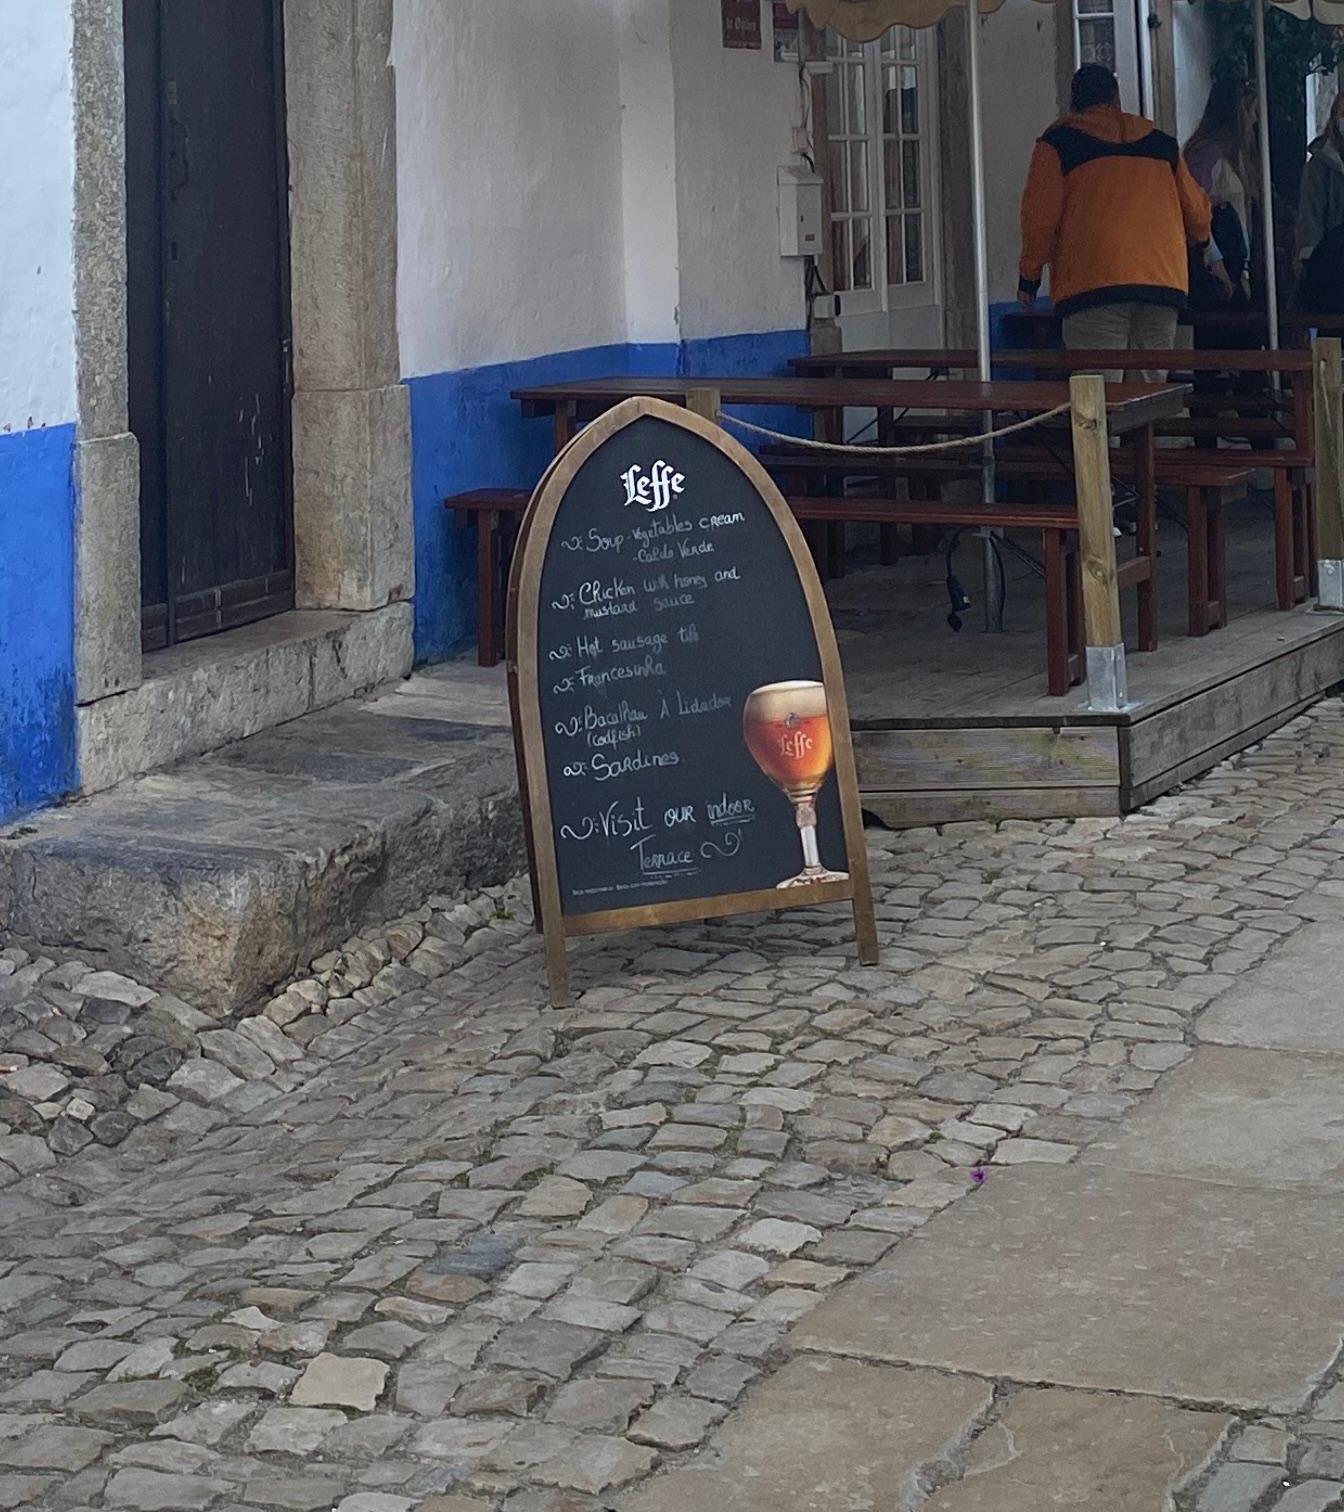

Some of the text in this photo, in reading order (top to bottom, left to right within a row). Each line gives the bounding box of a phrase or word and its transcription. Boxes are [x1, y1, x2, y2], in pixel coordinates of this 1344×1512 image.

[619, 459, 686, 512] Leffe
[586, 528, 624, 553] Soup
[677, 537, 715, 559] Verde
[579, 577, 636, 606] Chicken
[714, 566, 742, 582] and
[583, 593, 696, 620] mustard sauce
[577, 635, 603, 659] Hot
[611, 632, 669, 654] sausage
[575, 654, 666, 687] Francesinha
[584, 700, 649, 731] Bacalhau
[777, 731, 814, 760] Leffe
[591, 749, 680, 782] Sardines
[598, 796, 653, 837] Visit
[630, 834, 694, 872] Terrace
